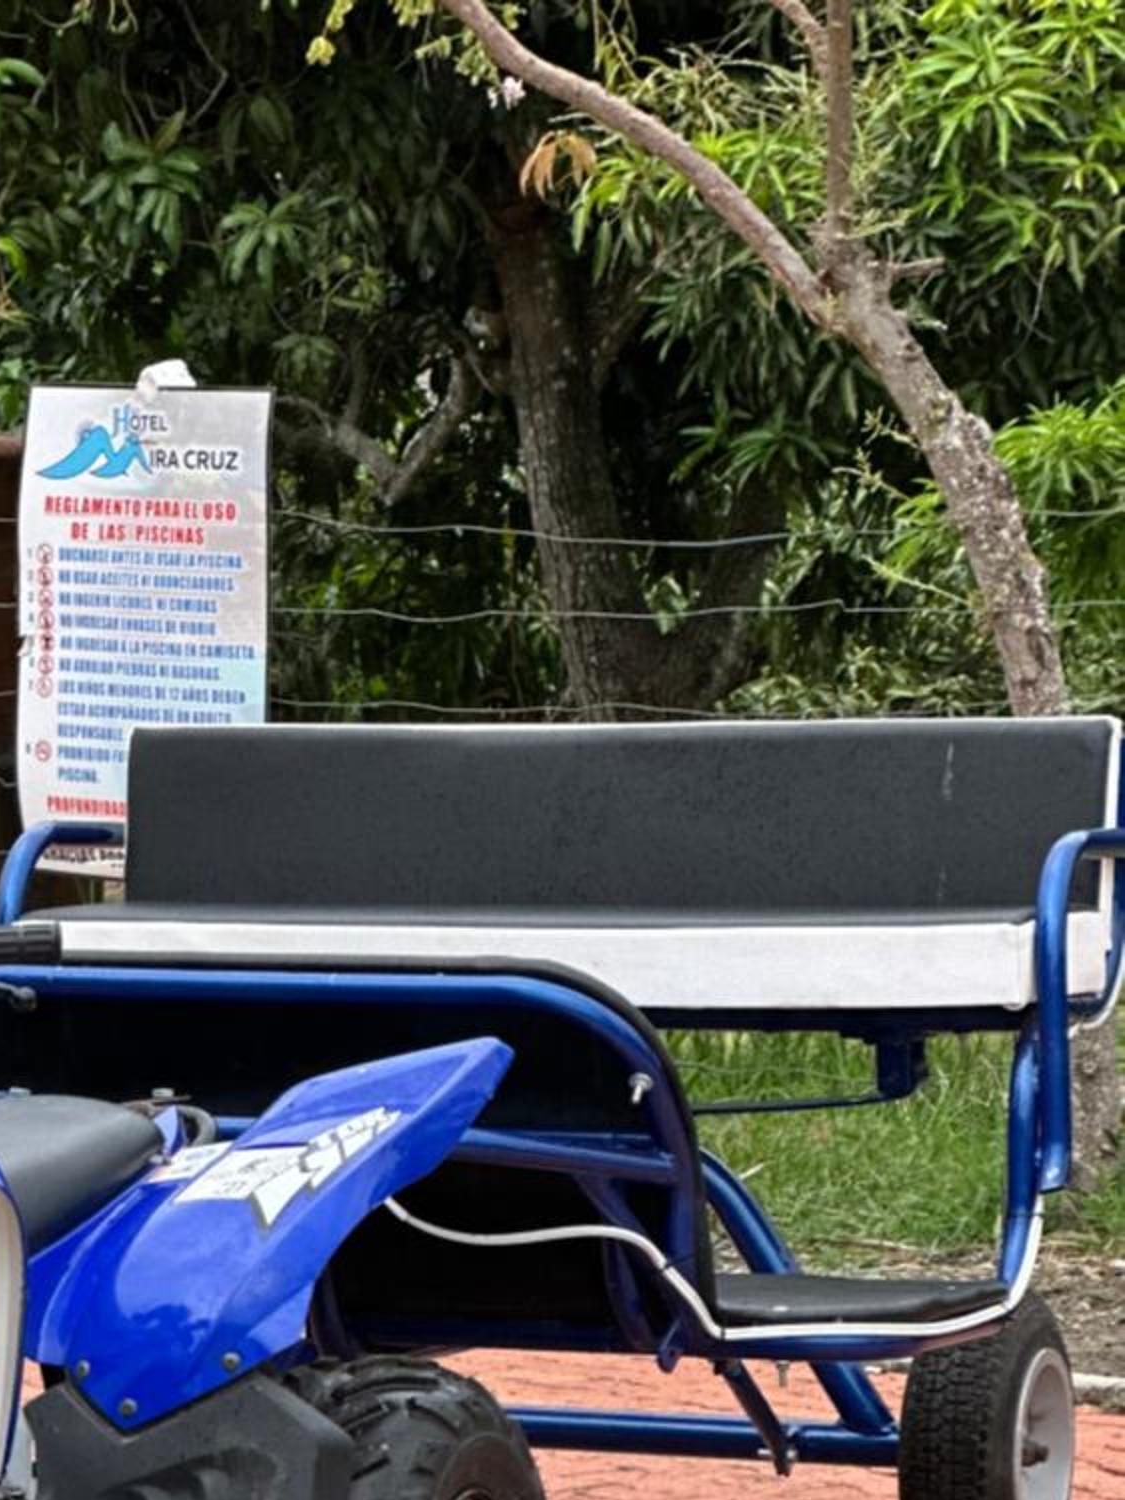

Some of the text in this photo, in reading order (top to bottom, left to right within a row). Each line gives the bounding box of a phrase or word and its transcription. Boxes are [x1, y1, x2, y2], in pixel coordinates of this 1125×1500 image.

[113, 404, 168, 436] HOTEL
[184, 450, 239, 471] CRUZ
[44, 496, 236, 521] REGLAMENTO PARA EL USO
[71, 522, 204, 545] DE LAS PISCINAS
[111, 550, 140, 565] ANTES
[143, 551, 155, 565] DE
[157, 552, 181, 566] USAR
[184, 553, 195, 567] LA
[197, 554, 242, 569] PISCINA
[59, 569, 71, 584] NO
[74, 570, 98, 585] USAR
[153, 575, 234, 592] BRONCEADORES
[59, 591, 71, 606] NO
[169, 599, 217, 613] COMIDAS
[60, 613, 72, 628] NO
[165, 620, 176, 634] DE
[61, 635, 72, 650] NO
[75, 636, 118, 652] INGRESAR
[129, 640, 140, 654] LA
[142, 641, 182, 656] PISCINA
[185, 643, 197, 657] EN
[199, 644, 254, 660] CAMISETA
[60, 657, 71, 673] NO
[58, 679, 75, 694] LOS
[107, 683, 152, 699] MENORES
[155, 685, 166, 699] DE
[181, 686, 208, 703] AÑOS
[211, 689, 246, 704] DEBEN
[58, 702, 86, 717] ESTAR
[163, 708, 174, 722] DE
[177, 708, 190, 723] UN
